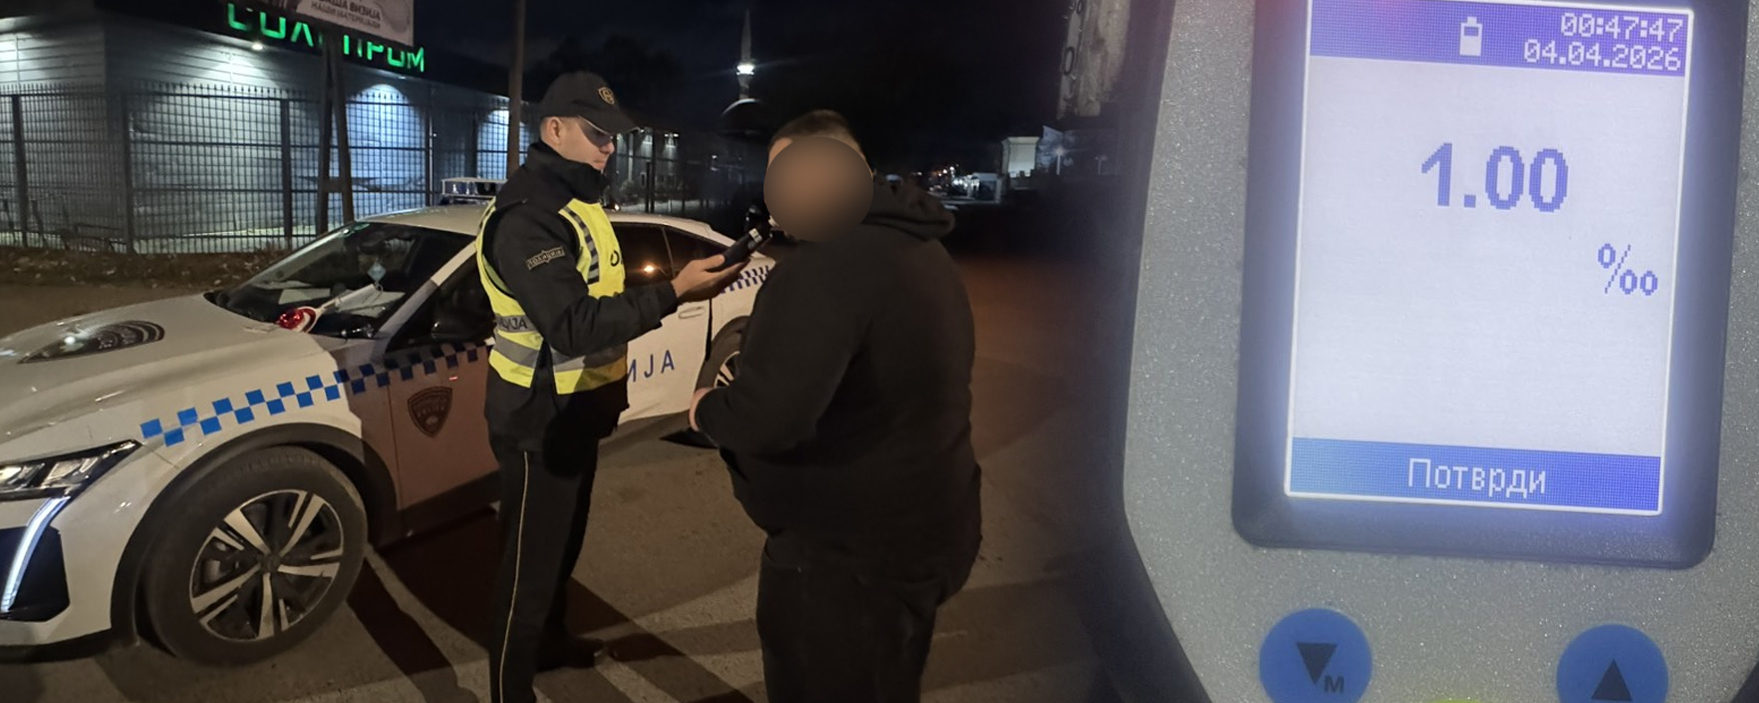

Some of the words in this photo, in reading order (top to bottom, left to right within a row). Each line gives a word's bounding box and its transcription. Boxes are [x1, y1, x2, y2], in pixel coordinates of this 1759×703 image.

[1560, 13, 1684, 43] 00:47:47
[1523, 38, 1682, 71] 04.04.2026
[1421, 142, 1569, 213] 1.00
[1407, 458, 1547, 499] Потврди
[1324, 675, 1345, 694] M
